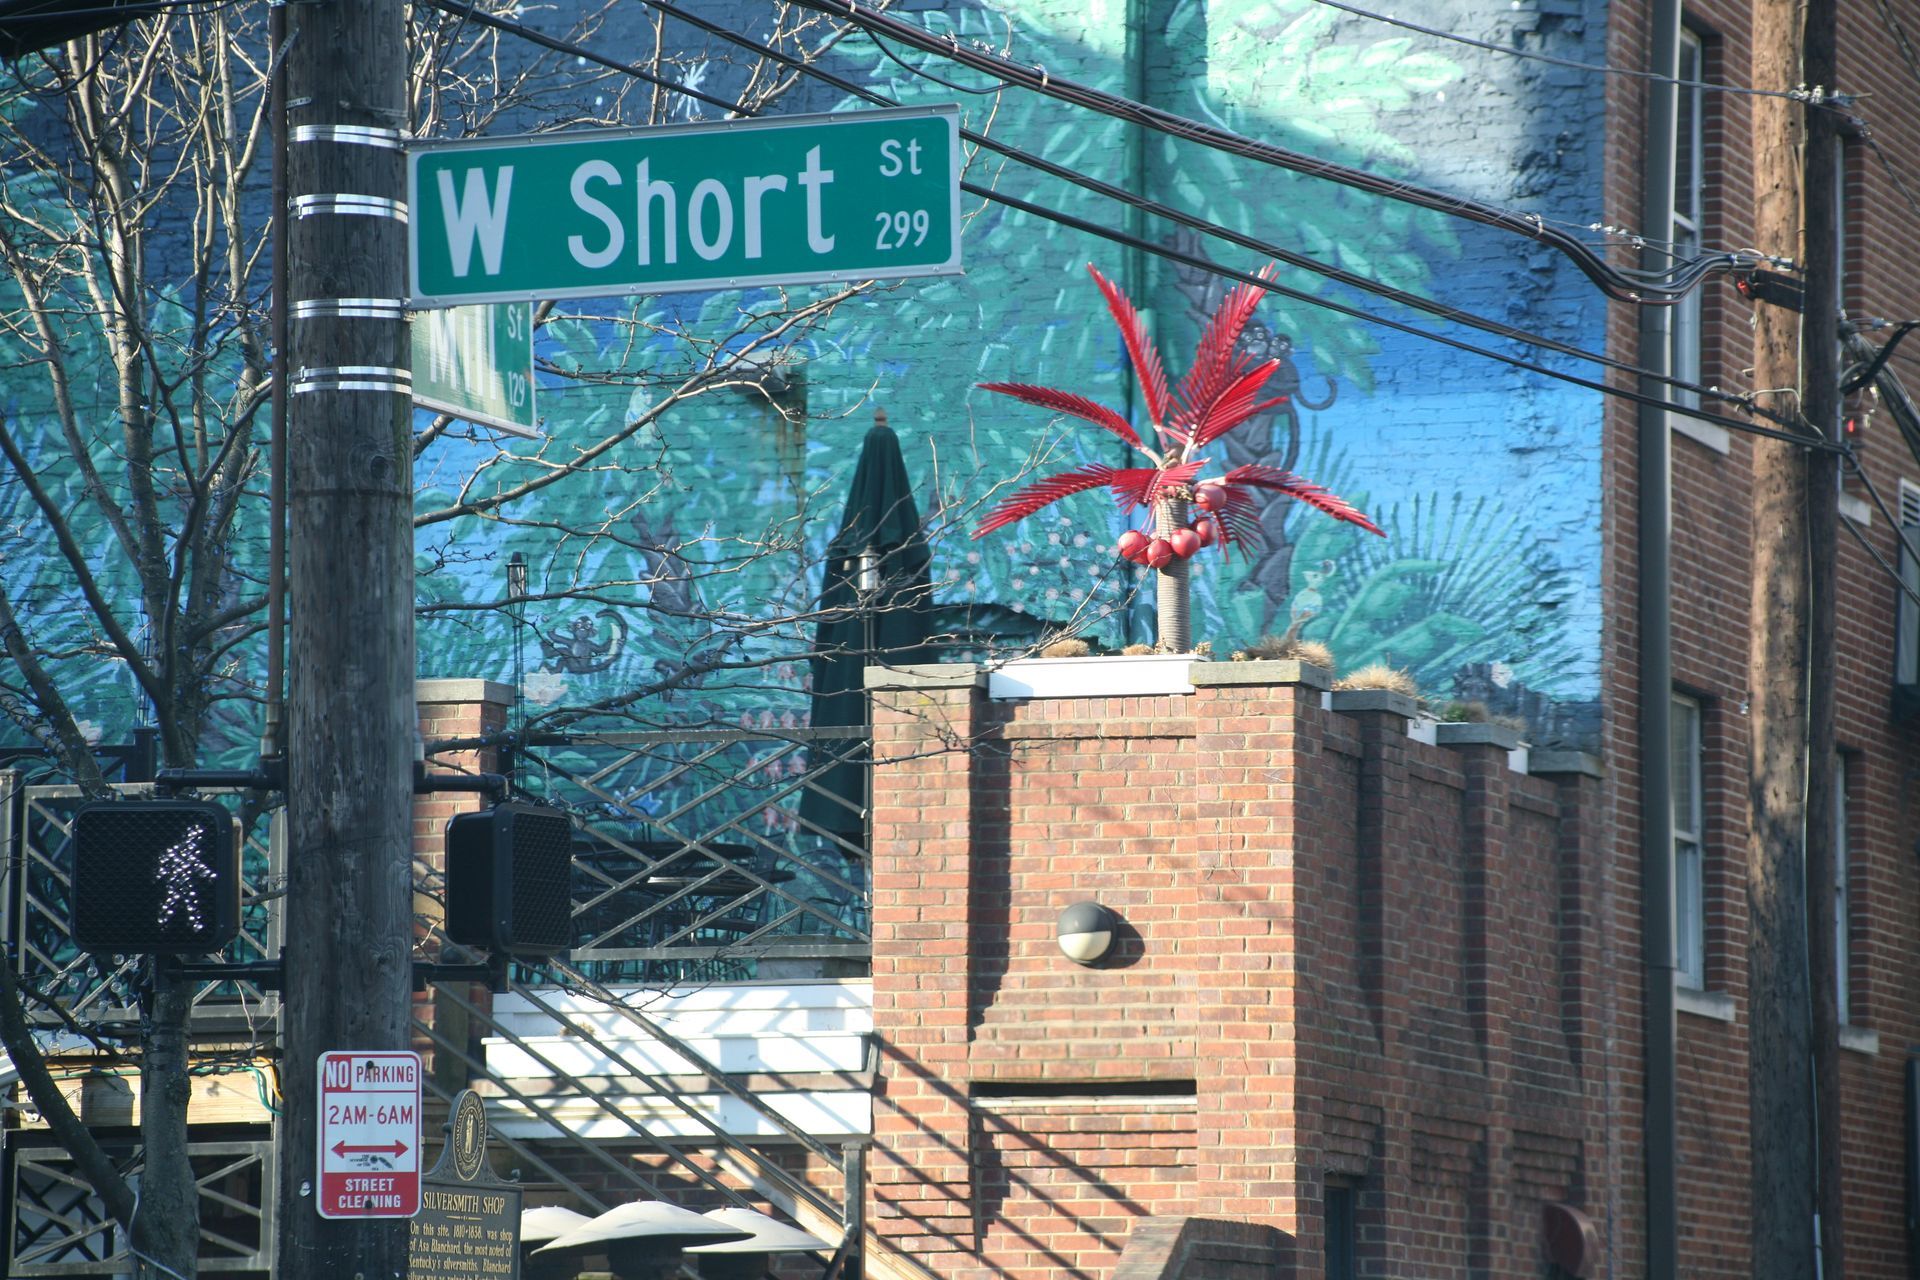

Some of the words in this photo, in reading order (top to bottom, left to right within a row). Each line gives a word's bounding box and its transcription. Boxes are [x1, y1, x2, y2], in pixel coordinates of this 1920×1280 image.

[437, 165, 514, 278] W
[567, 144, 836, 269] Short
[879, 137, 922, 177] St
[875, 209, 930, 250] 299
[429, 304, 497, 400] Mill
[507, 304, 522, 341] St
[508, 371, 525, 407] 129
[325, 1060, 349, 1088] NO
[356, 1065, 414, 1083] PARKING
[328, 1104, 413, 1125] 2AM-6AM
[345, 1178, 395, 1192] STREET
[338, 1194, 401, 1209] CLEANING
[423, 1191, 479, 1213] SILVERSMITH
[482, 1196, 505, 1215] SHOP
[410, 1220, 419, 1235] On
[423, 1222, 434, 1236] this
[487, 1230, 497, 1240] was
[500, 1228, 513, 1244] shop
[410, 1238, 417, 1251] of
[418, 1239, 430, 1252] Asa
[464, 1242, 474, 1255] the
[475, 1243, 488, 1257] most
[489, 1244, 504, 1257] noted
[505, 1245, 512, 1257] of
[409, 1254, 441, 1271] Kentucky's
[482, 1258, 512, 1273] Blanchard
